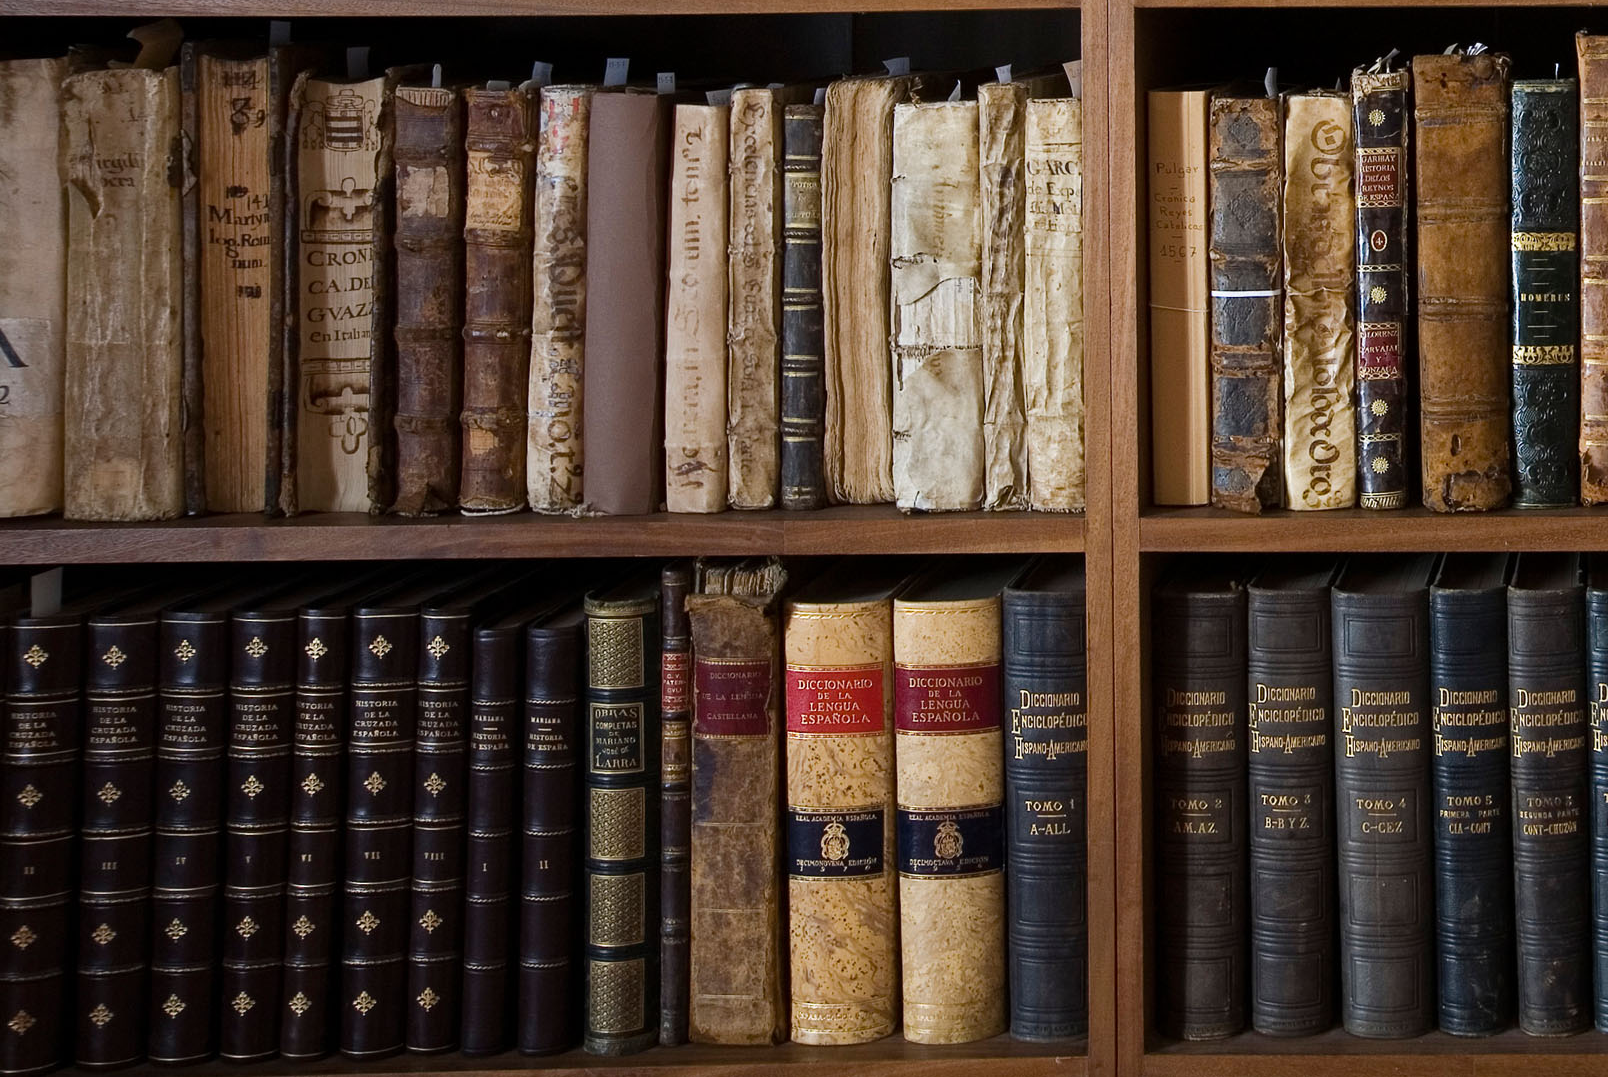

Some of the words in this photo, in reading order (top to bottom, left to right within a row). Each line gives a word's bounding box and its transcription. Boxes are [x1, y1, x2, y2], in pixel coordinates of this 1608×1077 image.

[1362, 184, 1394, 192] REYNOS
[797, 678, 873, 691] DICCIONARIO
[909, 676, 983, 689] DICCIONARIO
[838, 692, 852, 700] LA
[928, 690, 942, 698] DE
[949, 689, 962, 697] LA
[1256, 683, 1316, 703] DICCIONARIO
[1351, 689, 1410, 708] DICCIONARIO
[355, 700, 399, 708] HISTORIA
[920, 699, 971, 710] LENGUA
[1019, 689, 1080, 710] DICCIONARIO
[235, 704, 279, 712] HISTORIA
[809, 701, 861, 712] LENGUA
[379, 710, 390, 718] LA
[595, 708, 638, 719] OBRAS
[706, 712, 759, 720] CASTELLANA
[800, 712, 871, 725] ESPAÑOLA
[911, 710, 981, 723] ESPAÑOLA
[1249, 702, 1325, 728] ENCICLOPÉDICO
[354, 720, 399, 728] CRUZADA
[1342, 707, 1419, 733] ENCICLOPÉDICO
[595, 722, 637, 730] COMPLETAS
[233, 732, 279, 742] ESPAÑOLA
[352, 729, 400, 738] ESPAÑOLA
[528, 733, 564, 741] HISTORIA
[596, 736, 636, 745] MARIANO
[1251, 730, 1325, 754] HISPANO-AMERICANO
[539, 742, 568, 751] ESPAÑA
[594, 754, 637, 768] LARRA
[1025, 801, 1063, 811] TOMO
[1261, 795, 1298, 806] TOMO
[1357, 799, 1394, 810] TOMO
[1447, 797, 1481, 807] TOMO
[1485, 796, 1492, 805] 5
[1029, 823, 1071, 835] A-ALL
